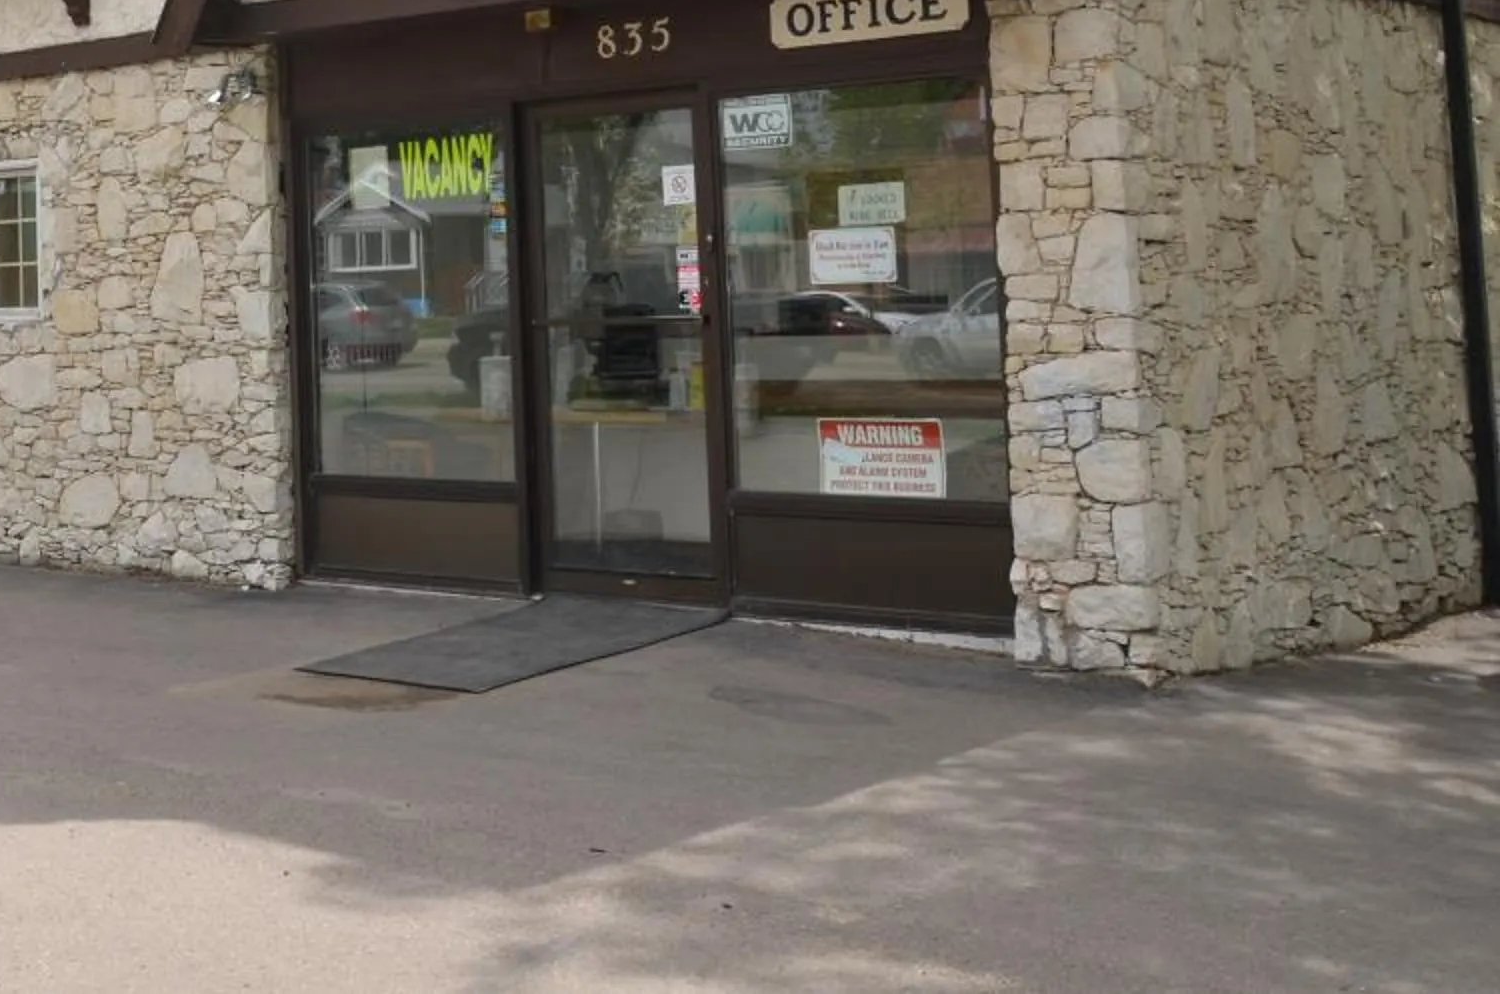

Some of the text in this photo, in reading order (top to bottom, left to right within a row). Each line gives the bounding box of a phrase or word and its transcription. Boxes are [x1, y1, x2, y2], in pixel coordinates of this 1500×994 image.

[596, 16, 671, 59] 835
[398, 131, 494, 200] VACANCY
[836, 423, 925, 446] WARNING
[895, 453, 935, 465] CAMERA
[891, 467, 928, 479] SYSTEM
